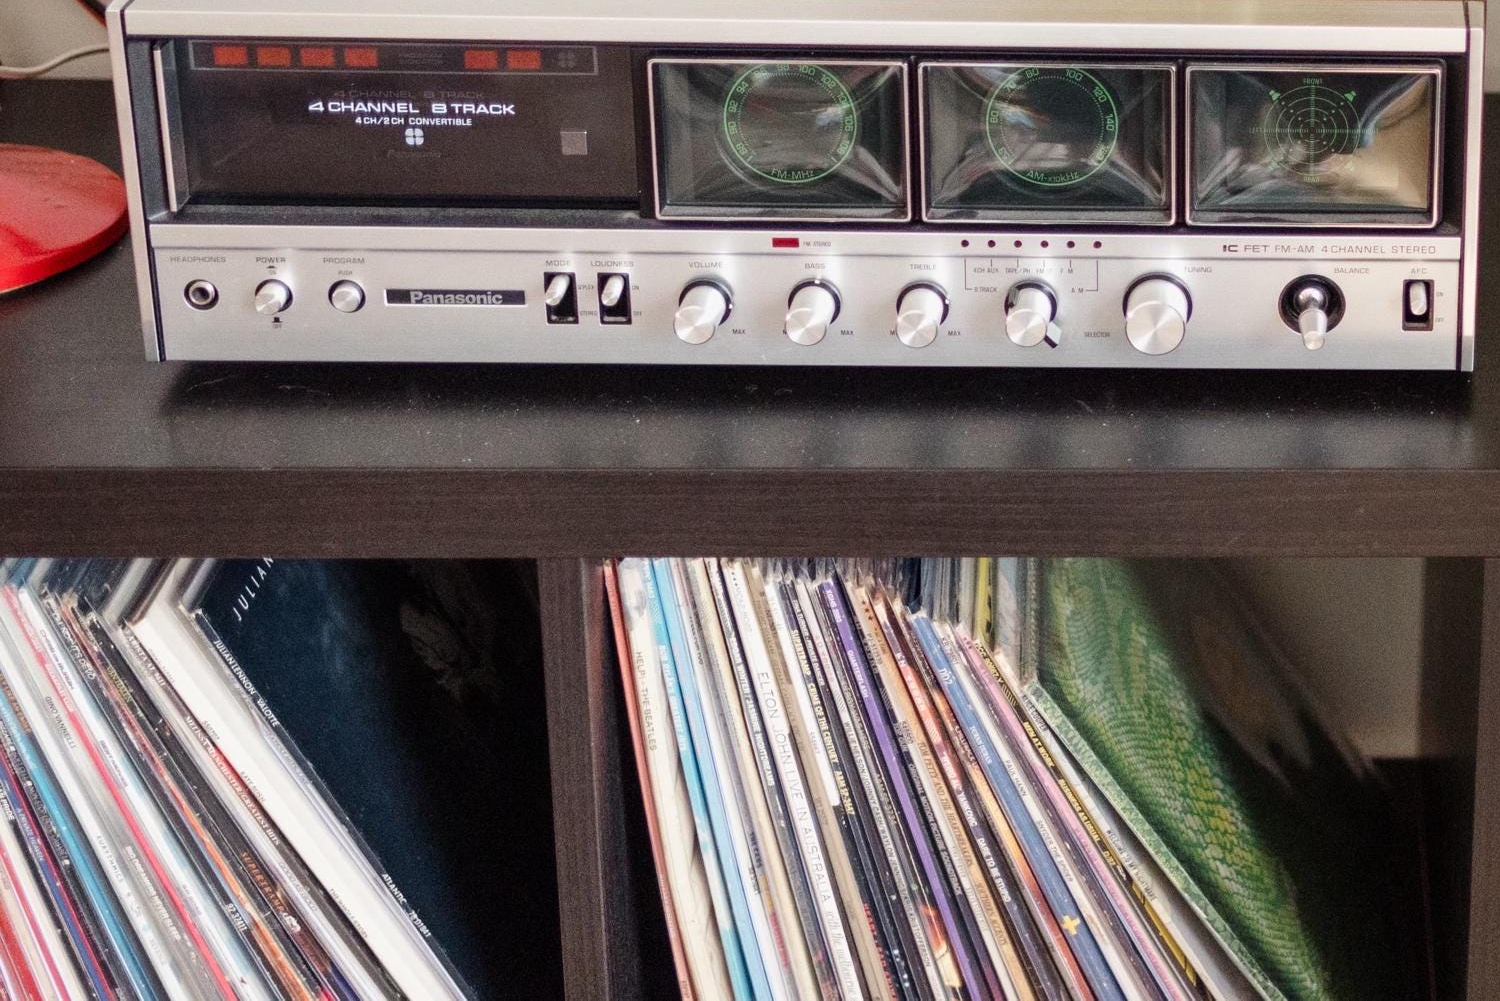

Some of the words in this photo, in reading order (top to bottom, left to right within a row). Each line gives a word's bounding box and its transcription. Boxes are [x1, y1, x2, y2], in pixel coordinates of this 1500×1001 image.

[736, 81, 749, 94] 94
[820, 74, 837, 89] 102
[1065, 69, 1084, 81] 100
[308, 101, 325, 112] 4
[328, 102, 419, 114] CHANNEL
[432, 103, 447, 114] 8
[450, 103, 515, 115] TRACK
[728, 100, 739, 113] 92
[1092, 86, 1107, 103] 120
[408, 117, 472, 126] CONVERTIBLE
[845, 115, 854, 132] 106
[1105, 113, 1114, 131] 140
[1244, 245, 1269, 253] FET
[1274, 245, 1315, 253] FM-AM
[1330, 246, 1386, 254] CHANNEL
[1391, 246, 1436, 254] STEREO
[410, 290, 503, 305] Panasonic
[792, 598, 801, 612] TINA
[796, 611, 809, 636] TURNER
[790, 629, 811, 676] SUPERTRAMP
[805, 639, 818, 662] PRIVATE
[634, 651, 646, 679] HELP!
[812, 662, 825, 686] DANCER
[846, 648, 869, 698] QUARTERFLASH
[213, 639, 235, 666] JULIAN
[230, 663, 256, 695] LENNON
[256, 697, 279, 727] VALOTTE
[640, 687, 650, 706] THE
[757, 670, 780, 719] ELTON
[807, 682, 821, 706] CRIME
[44, 695, 58, 714] GINO
[53, 713, 76, 749] VANNELLI
[814, 705, 824, 717] OF
[818, 717, 829, 731] THE
[1020, 693, 1034, 710] ALICE
[1030, 709, 1049, 732] COOPER
[643, 708, 657, 751] BEATLES
[736, 664, 750, 694] WINTER
[745, 699, 760, 732] JASMINE
[754, 732, 775, 786] NIGHTDREAMS
[771, 721, 793, 766] JOHN
[822, 730, 839, 764] CENTURY
[184, 715, 209, 745] MELISSA
[264, 828, 280, 846] HITS
[785, 768, 802, 801] LIVE
[842, 721, 857, 745] WILLIE
[850, 744, 878, 806] NELSON/JOHNNY
[871, 805, 896, 858] CASH/WAYLON
[1002, 759, 1016, 777] PAUL
[1012, 776, 1028, 798] HANN
[1022, 719, 1037, 738] MEN
[1037, 745, 1055, 768] WORK
[1057, 777, 1082, 812] BUSINESS
[1083, 820, 1101, 843] USUAL
[795, 804, 809, 825] IN
[917, 740, 929, 757] TOM
[924, 757, 939, 781] PETTY
[932, 780, 945, 797] AND
[939, 796, 951, 811] THE
[945, 810, 975, 867] HEARTBREAKERS
[956, 791, 977, 827] YANKOVIC
[907, 762, 925, 796] ORIGINAL
[919, 795, 935, 822] MOTION
[929, 821, 946, 851] PICTURE
[940, 850, 963, 896] SOUNDTRACK
[29, 835, 45, 861] HEAVEN
[95, 834, 124, 884] EURYTHMICS
[976, 836, 991, 857] DARE
[1035, 818, 1053, 844] SNYDER
[1057, 858, 1074, 883] SPIDER
[800, 826, 831, 903] AUSTRALIA
[985, 856, 995, 867] TO
[990, 866, 1000, 878] BE
[131, 857, 156, 896] DREAMERS
[152, 895, 170, 920] NEVER
[240, 850, 285, 914] SUPERTRAMP
[381, 872, 406, 905] ATLANTIC
[994, 876, 1011, 903] STUPID
[831, 931, 843, 944] the
